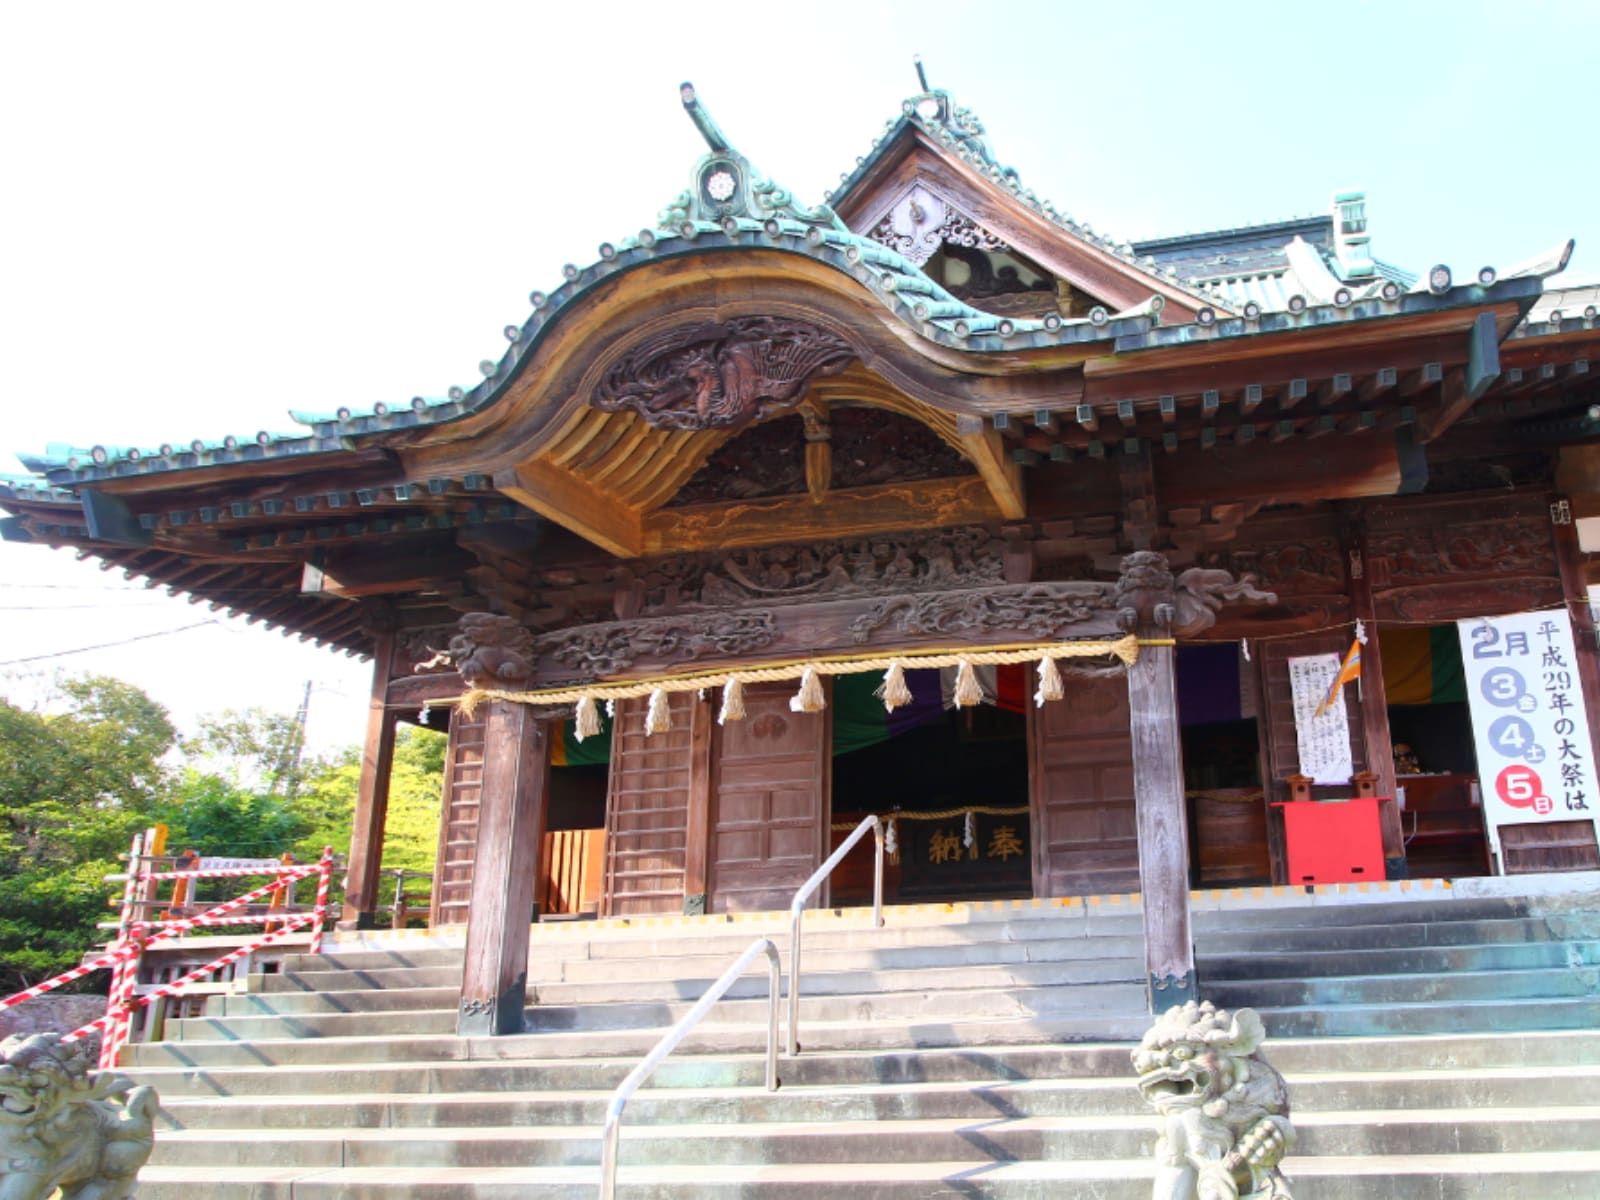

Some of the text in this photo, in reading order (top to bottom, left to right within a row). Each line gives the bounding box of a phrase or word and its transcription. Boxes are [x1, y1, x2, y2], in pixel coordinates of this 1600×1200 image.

[1471, 625, 1530, 660] 2月
[1536, 620, 1590, 811] 平成29年の大祭は
